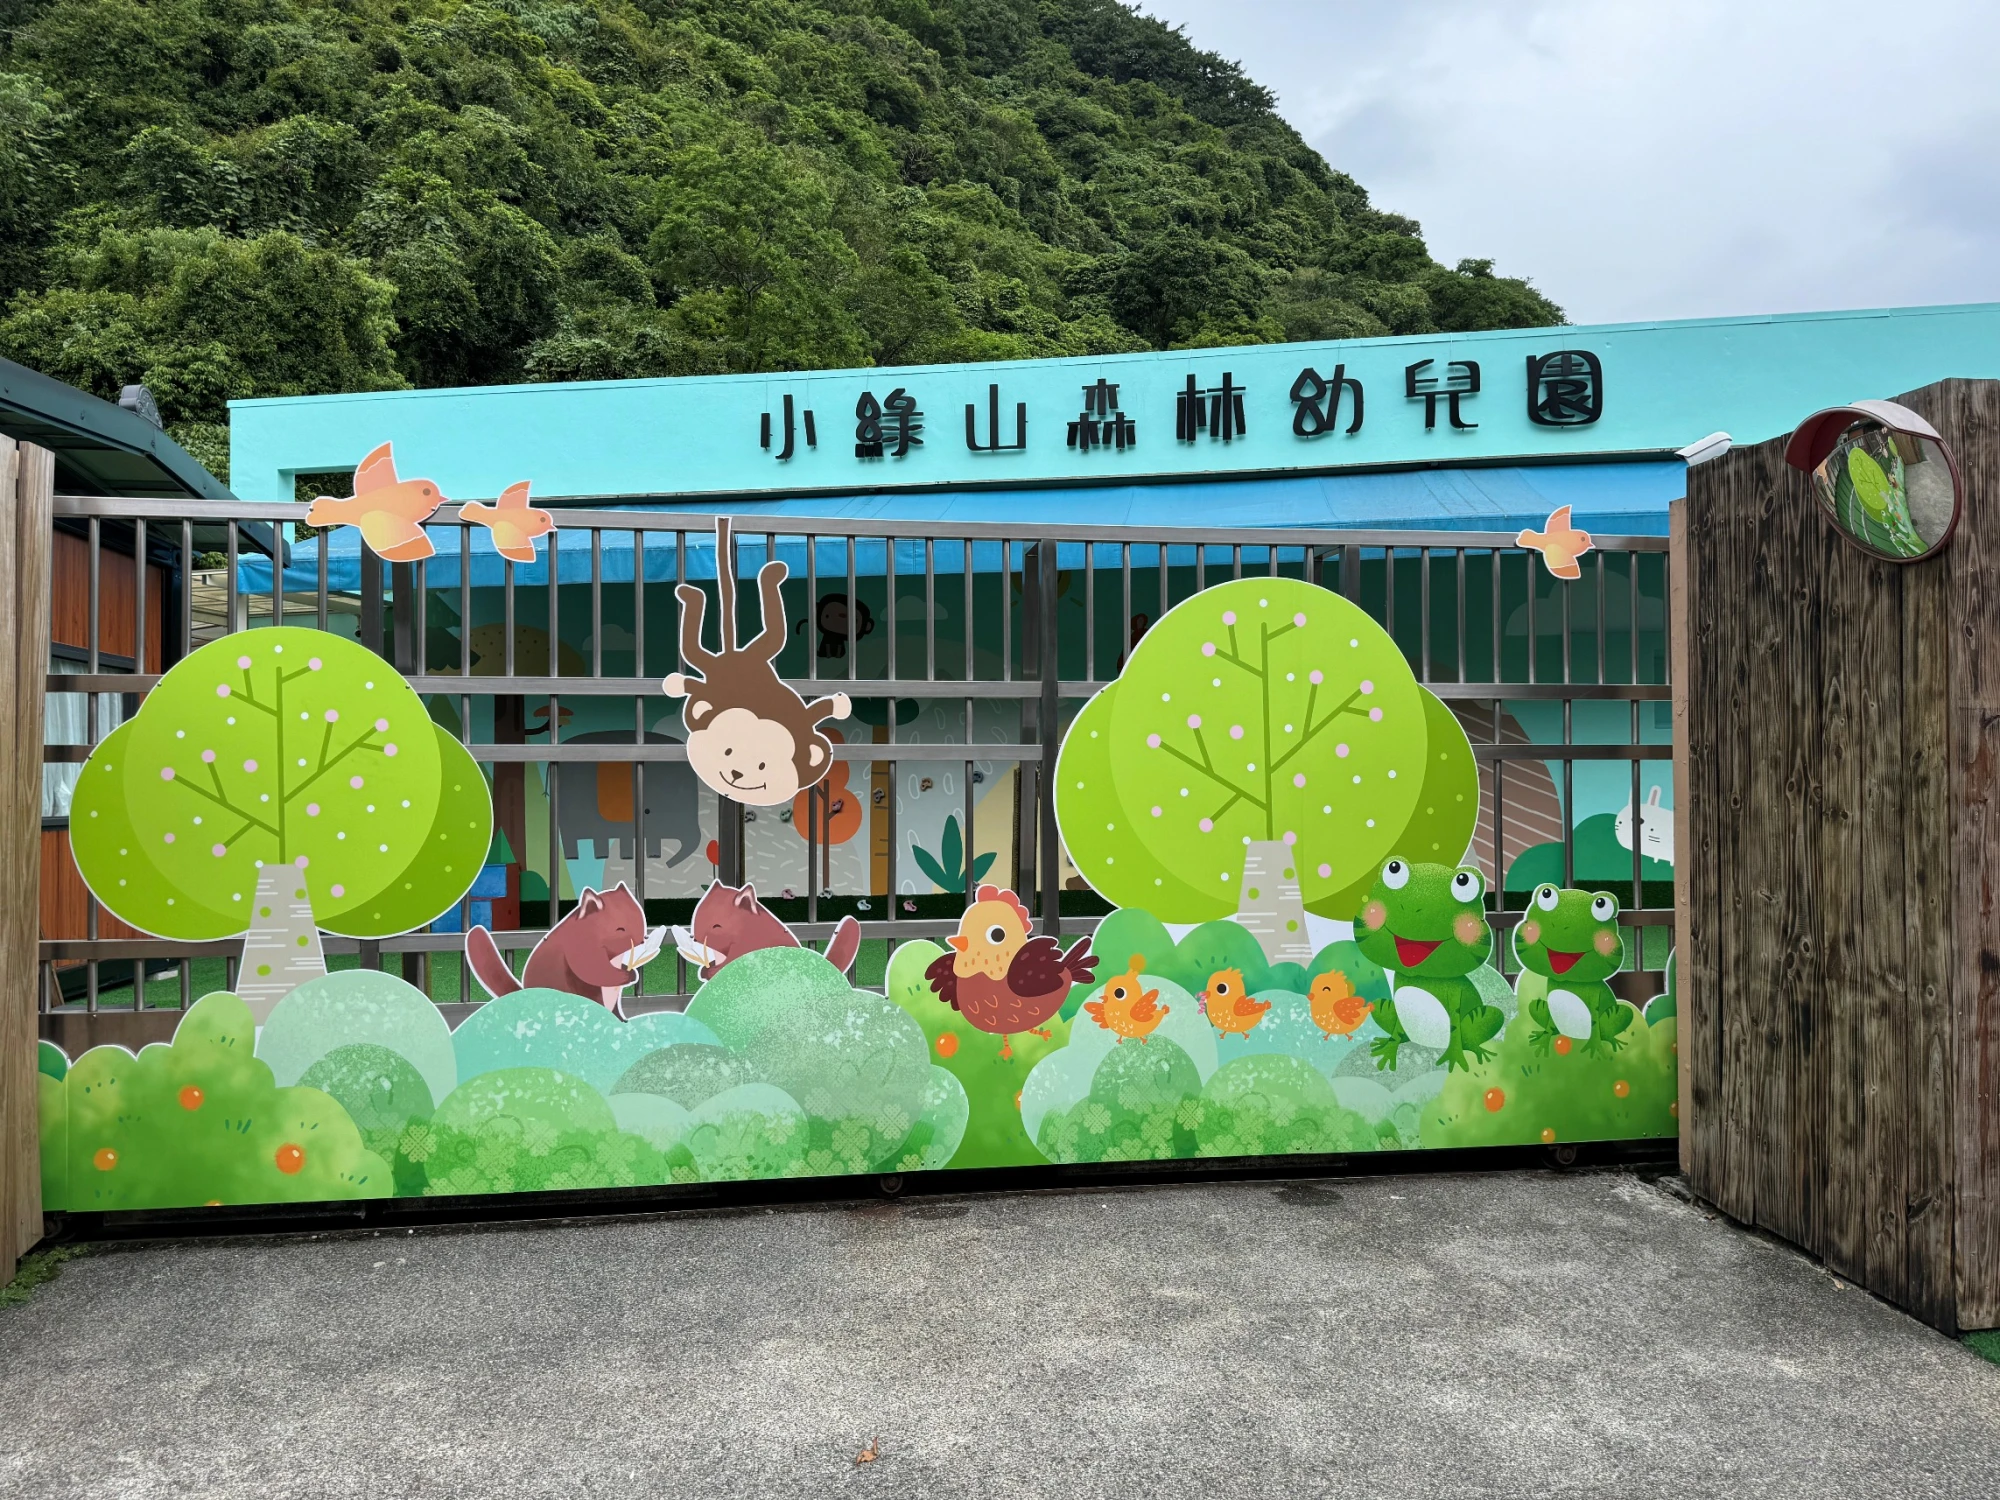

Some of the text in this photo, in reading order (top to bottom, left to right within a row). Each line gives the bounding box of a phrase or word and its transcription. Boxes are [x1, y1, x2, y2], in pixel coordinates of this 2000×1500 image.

[760, 350, 1602, 461] 小綠山森林幼兒園
